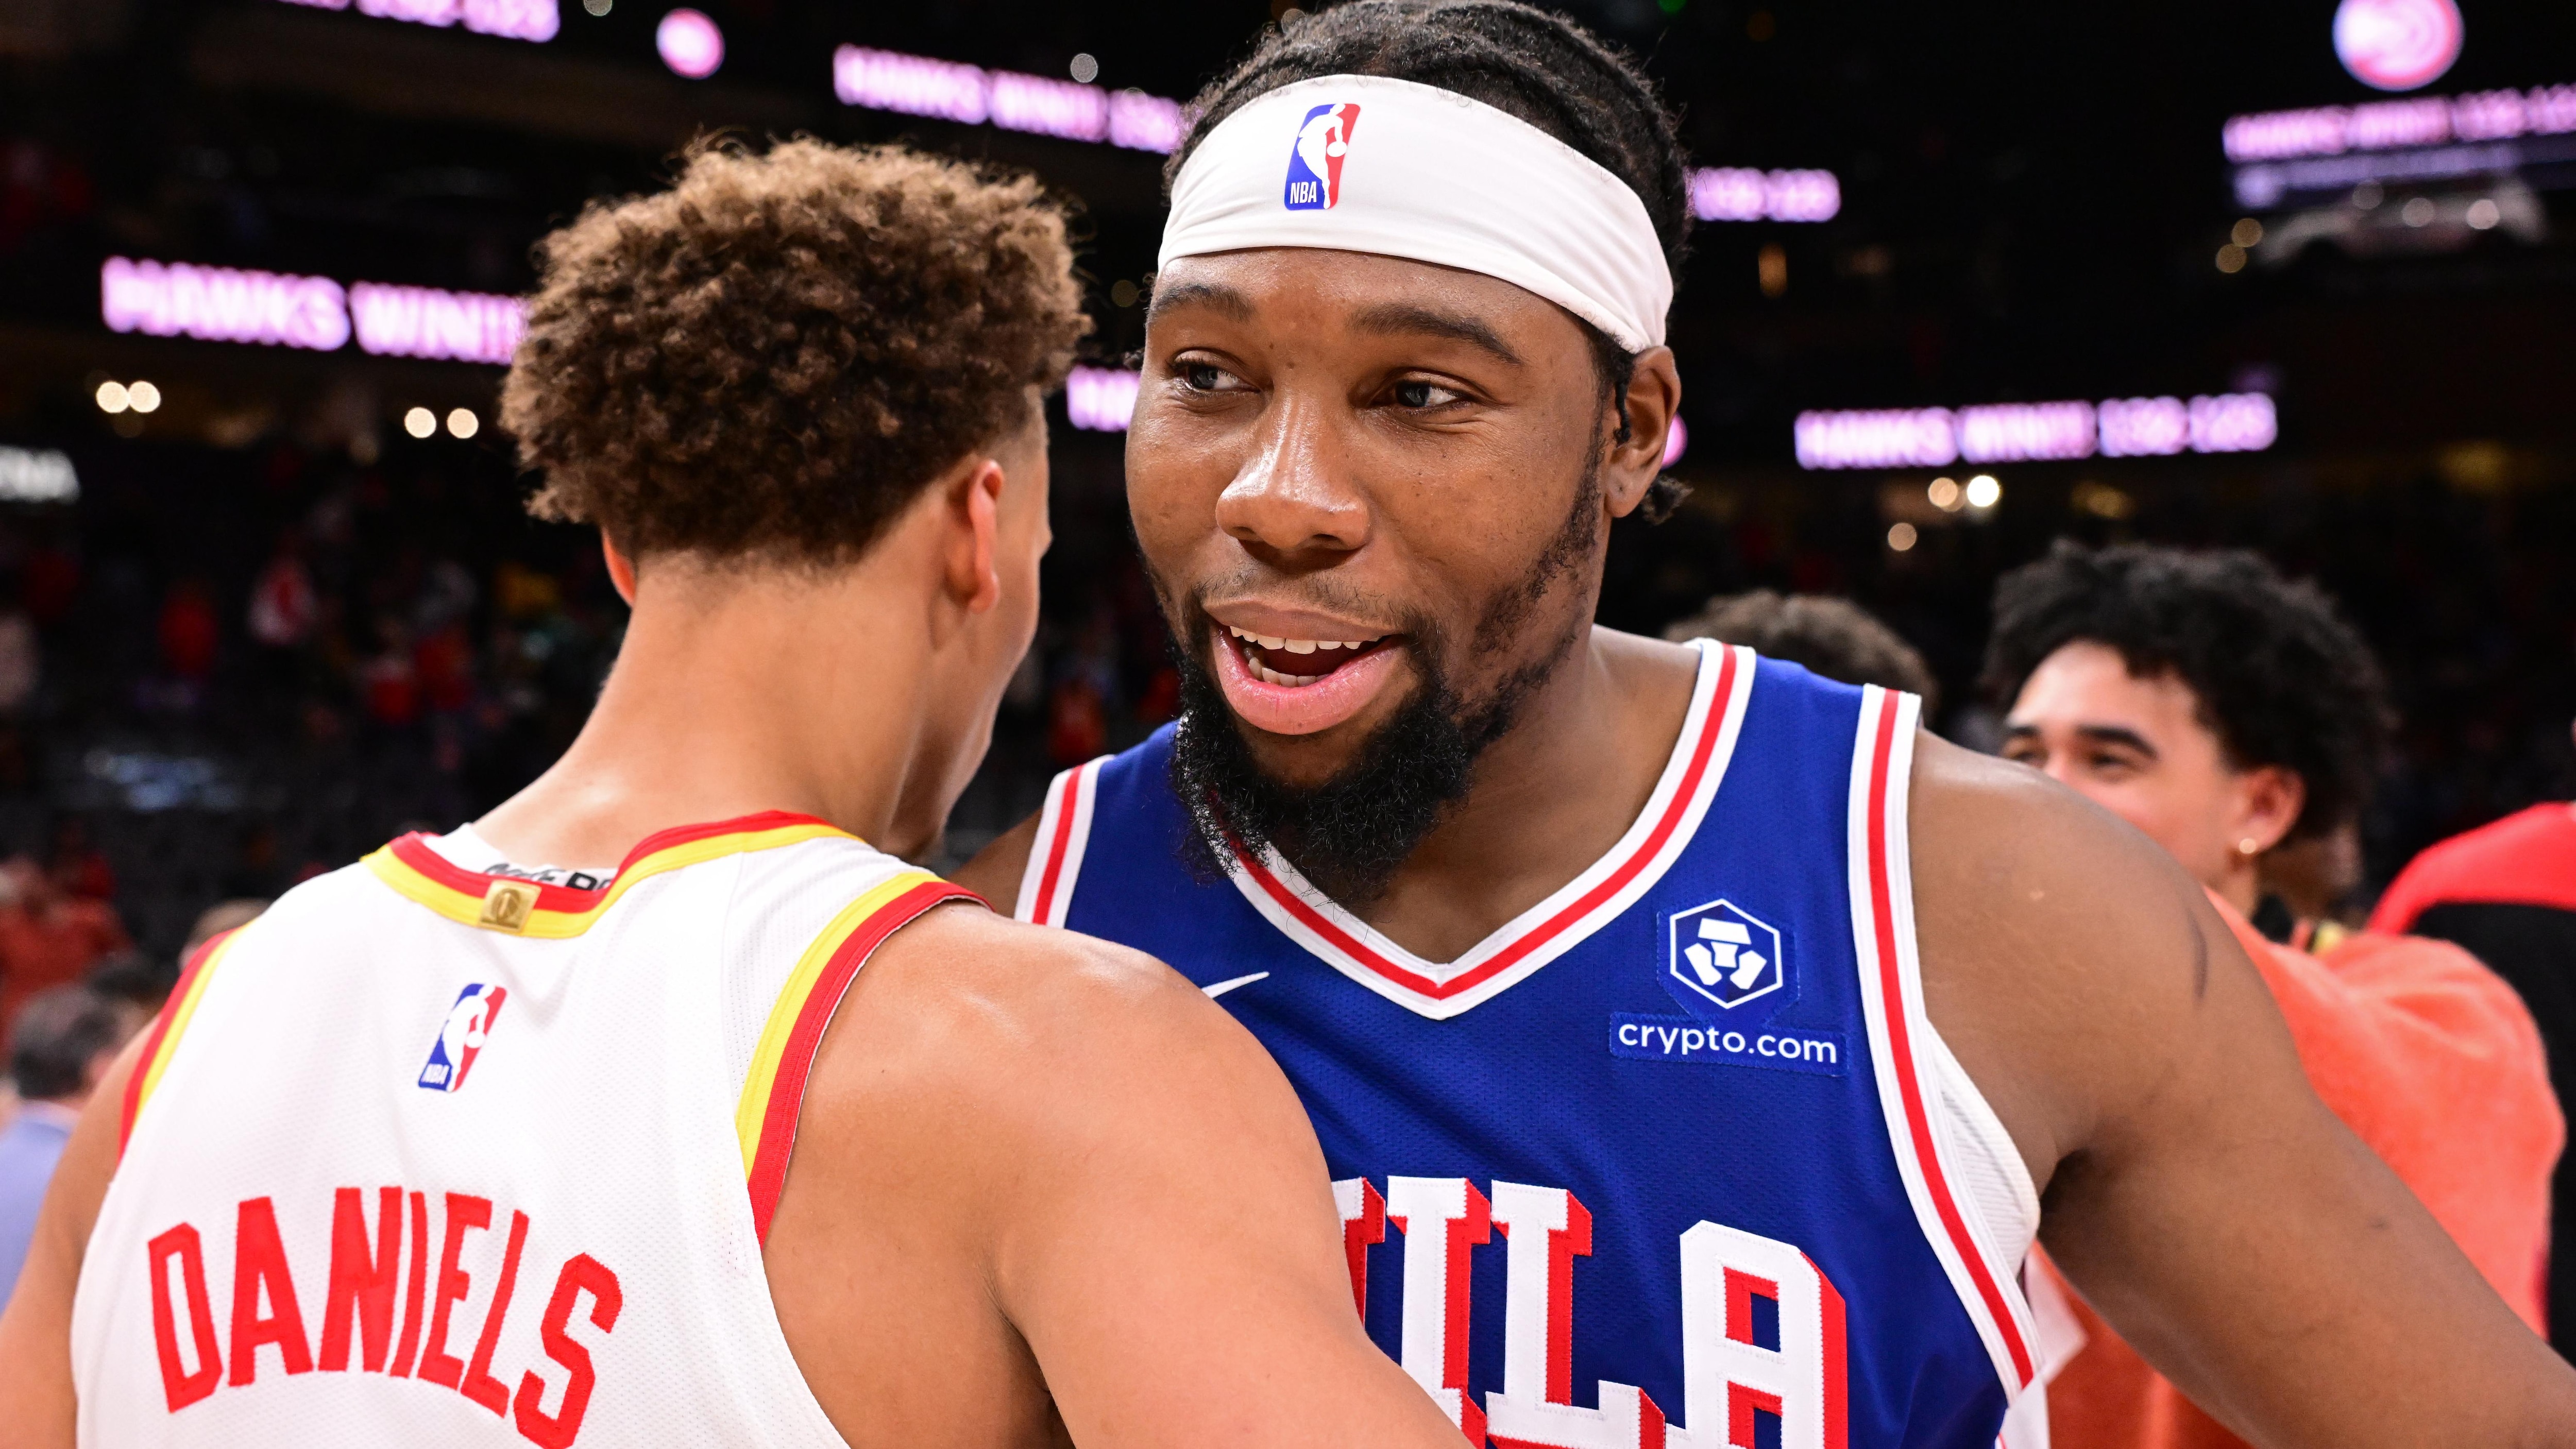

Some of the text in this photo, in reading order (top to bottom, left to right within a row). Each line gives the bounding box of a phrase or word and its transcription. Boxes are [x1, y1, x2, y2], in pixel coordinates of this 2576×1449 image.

[1290, 181, 1317, 204] NBA
[103, 258, 348, 350] HAWKS
[1794, 407, 1955, 468] HAWKS
[1618, 1024, 1837, 1063] crypto.com
[420, 1064, 450, 1084] NBA
[148, 1187, 622, 1449] DANIELS
